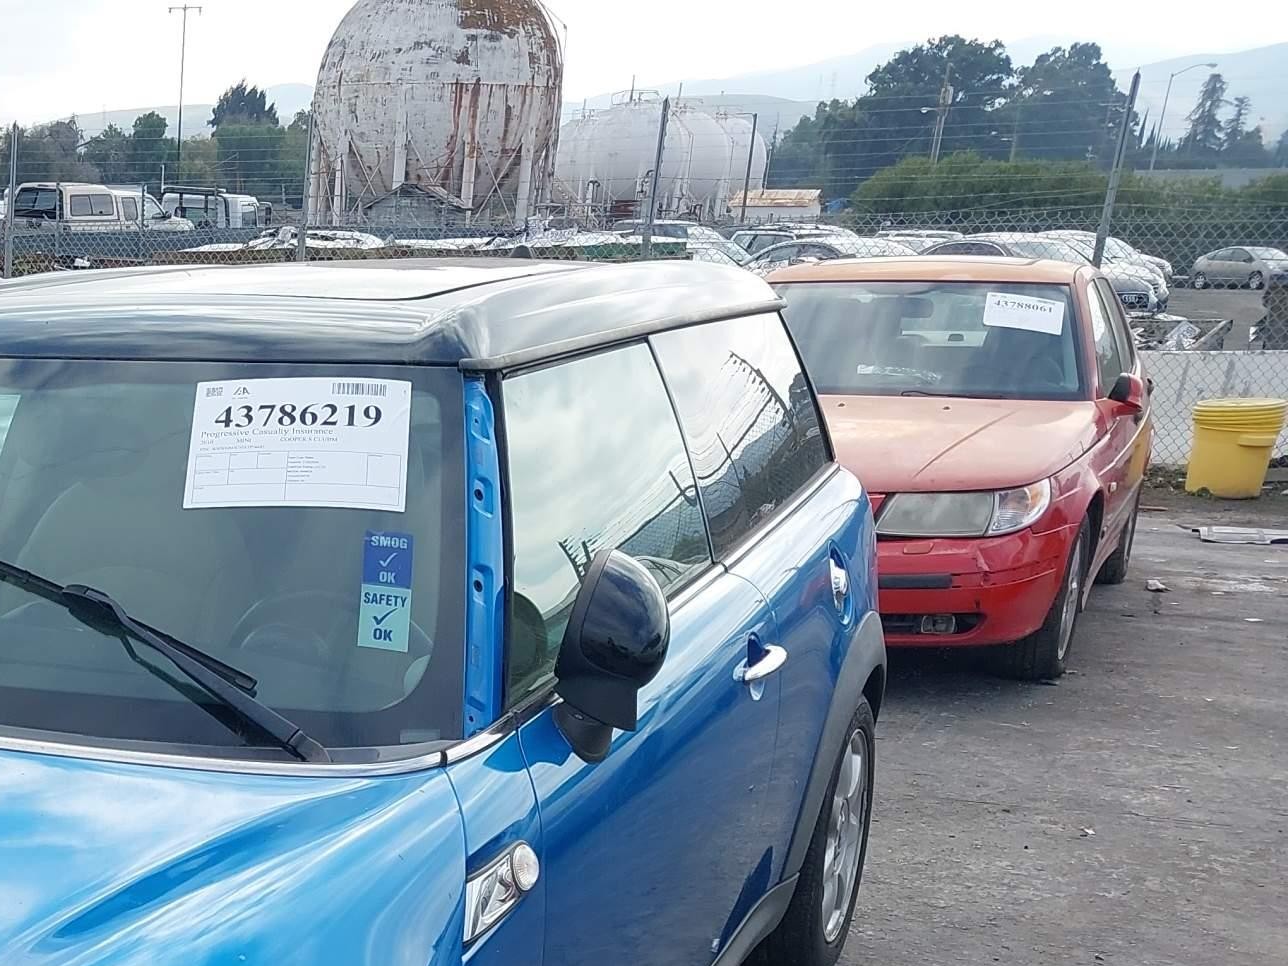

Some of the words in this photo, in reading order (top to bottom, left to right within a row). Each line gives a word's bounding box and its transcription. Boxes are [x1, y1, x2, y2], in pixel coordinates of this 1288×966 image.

[994, 300, 1053, 313] 43788061
[214, 403, 383, 428] 43786219
[201, 430, 250, 439] Progressive
[252, 427, 289, 436] Casualty
[292, 427, 334, 435] Insurance
[371, 535, 408, 549] SMOG
[379, 571, 396, 584] OK
[363, 592, 408, 608] SAFETY
[373, 628, 393, 642] OK
